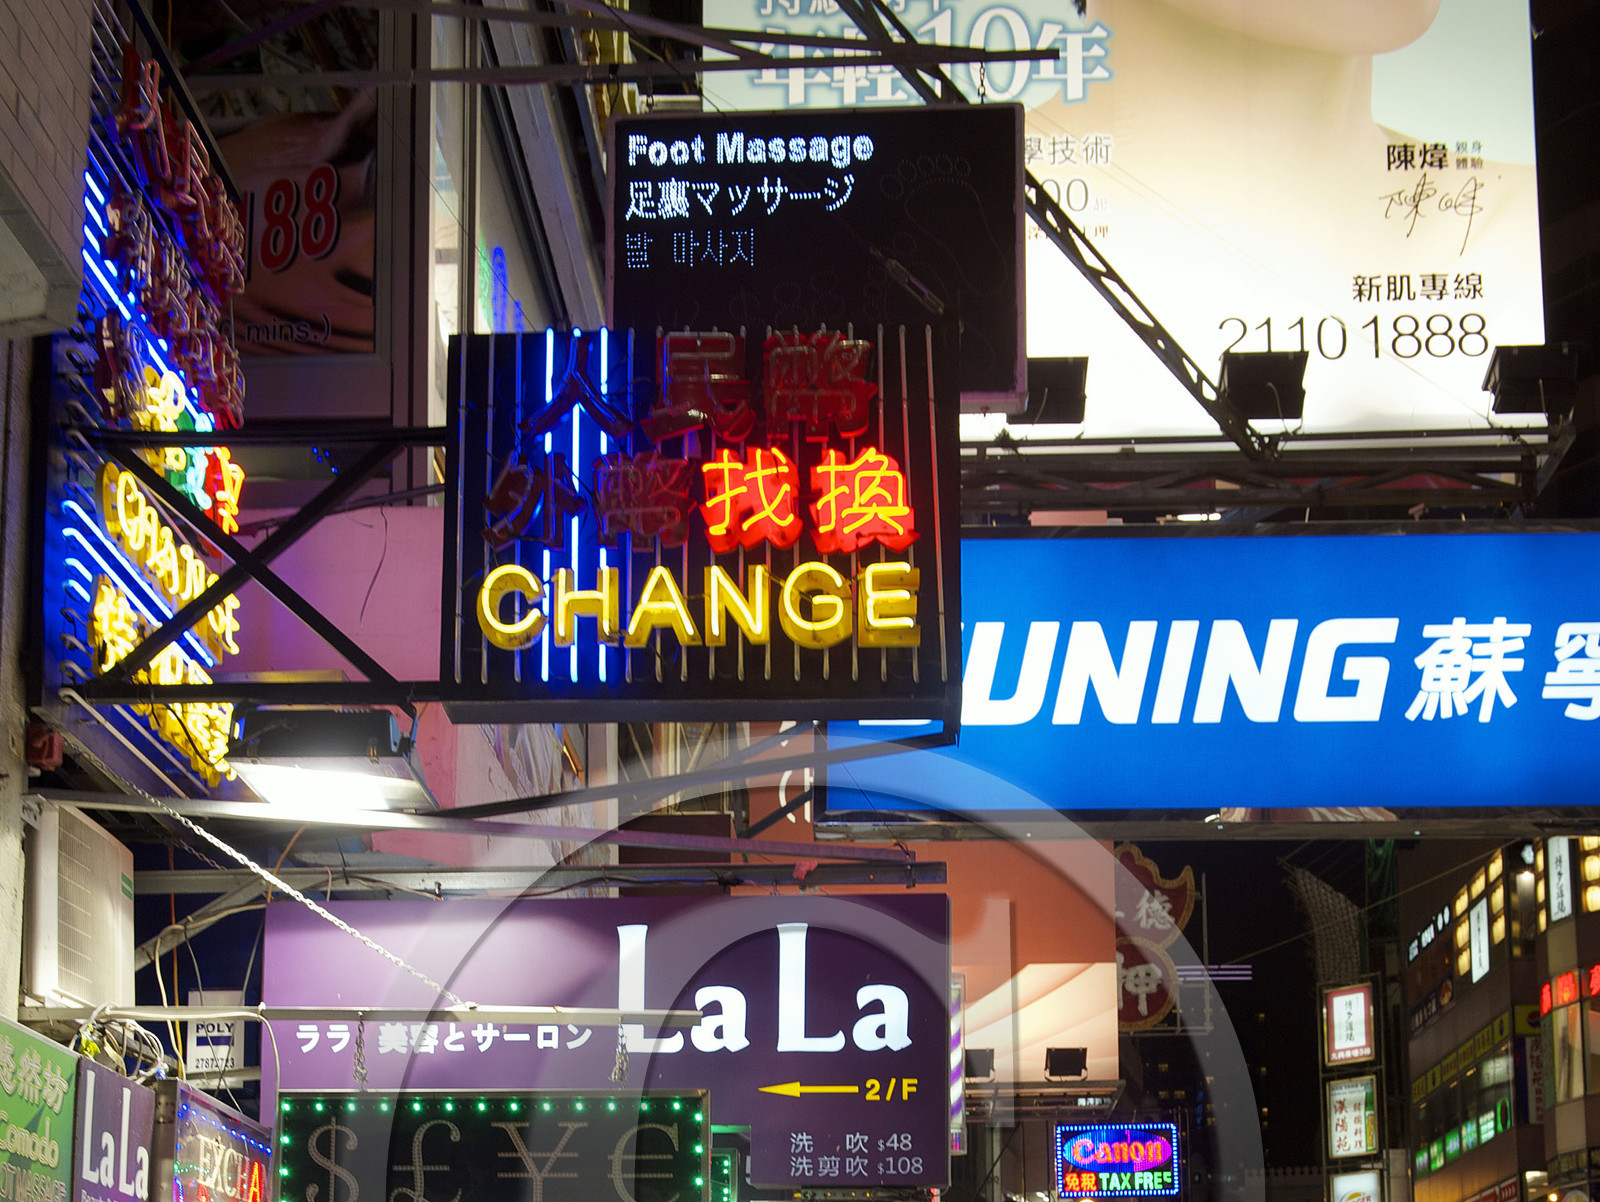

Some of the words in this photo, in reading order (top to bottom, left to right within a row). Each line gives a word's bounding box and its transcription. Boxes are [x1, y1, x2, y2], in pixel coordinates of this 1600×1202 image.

[628, 133, 705, 167] Foot
[716, 131, 875, 169] Massage
[626, 231, 653, 268] 발
[673, 228, 755, 268] 마사지
[1352, 272, 1484, 302] 新肌專線
[1362, 312, 1489, 360] 1888
[477, 561, 920, 650] CHANGE
[880, 617, 1399, 726] UNING
[196, 1022, 235, 1034] POLY
[296, 1025, 351, 1054] ララ
[864, 1077, 919, 1102] 2/F
[789, 1131, 814, 1153] 洗
[845, 1131, 869, 1153] 吹
[877, 1132, 913, 1152] $48
[1072, 1137, 1163, 1165] Canon
[789, 1155, 869, 1177] 洗剪吹
[877, 1156, 924, 1175] $108
[1099, 1172, 1131, 1191] TAX
